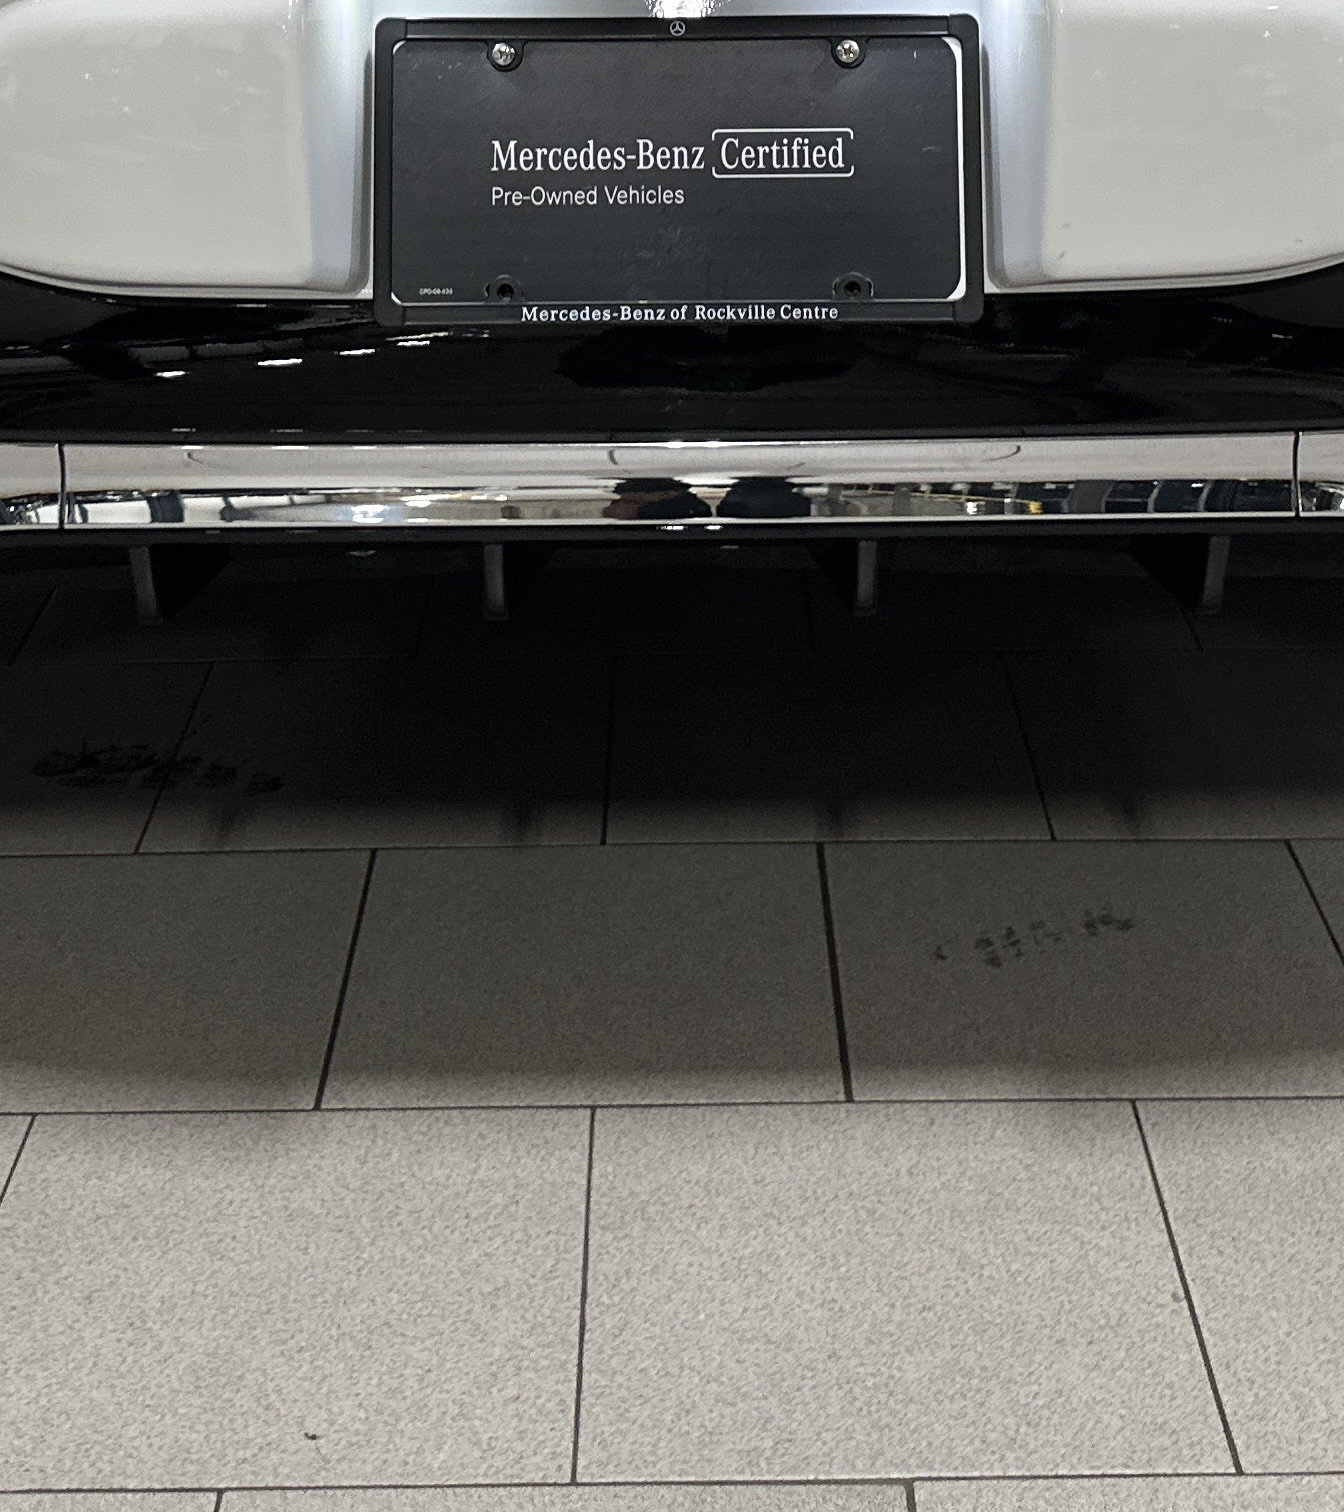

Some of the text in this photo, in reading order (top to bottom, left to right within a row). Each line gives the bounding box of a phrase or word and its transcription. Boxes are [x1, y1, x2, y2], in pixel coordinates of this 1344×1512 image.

[491, 137, 846, 172] Mercedes-Benz Certified
[491, 185, 685, 207] Pre-Owned Vehicles
[520, 304, 839, 322] Mercedes-Benz of Rockville Centre
